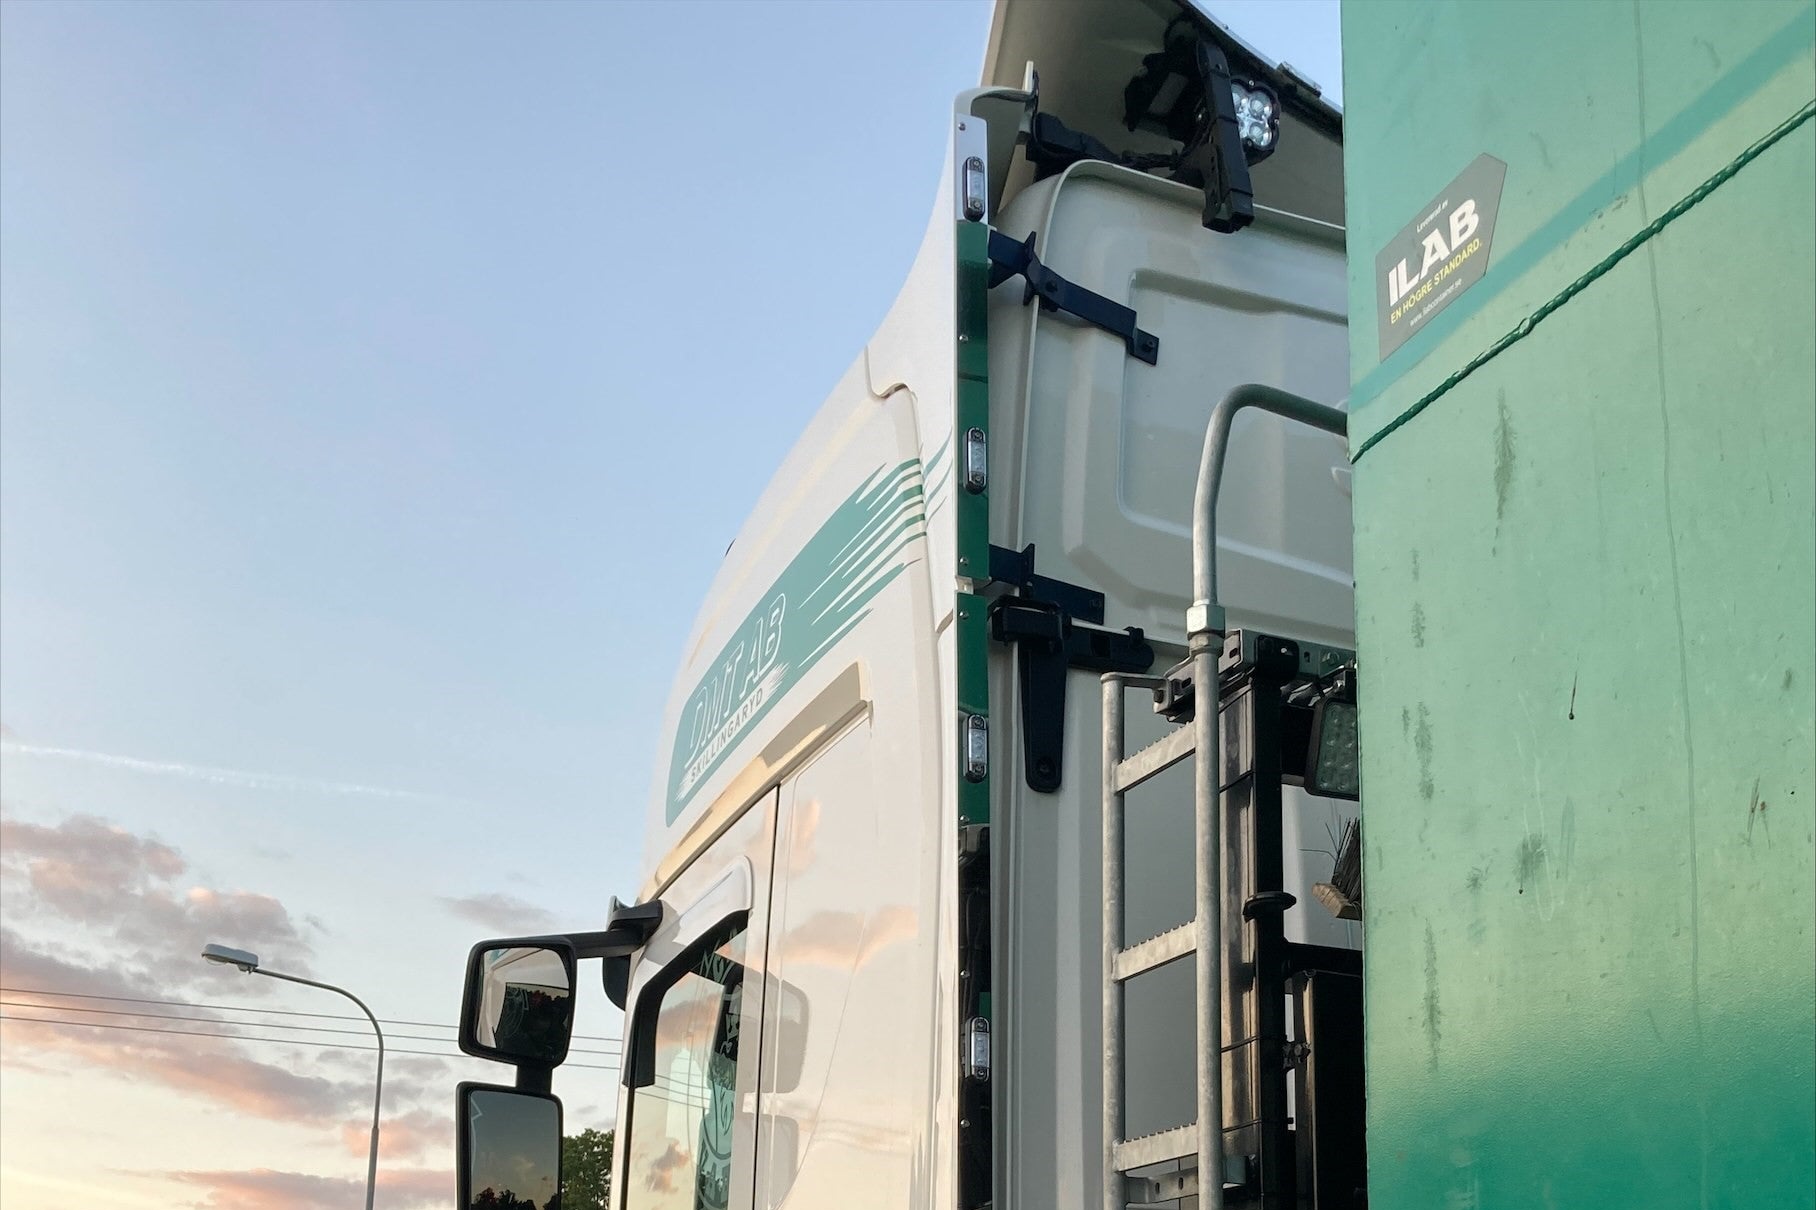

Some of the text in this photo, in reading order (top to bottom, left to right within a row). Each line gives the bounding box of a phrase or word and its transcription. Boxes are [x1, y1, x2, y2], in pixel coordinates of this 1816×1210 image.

[1388, 199, 1480, 307] ILAB
[1391, 307, 1402, 325] EN
[738, 592, 786, 700] AB
[689, 686, 764, 783] SKILLINGARYD
